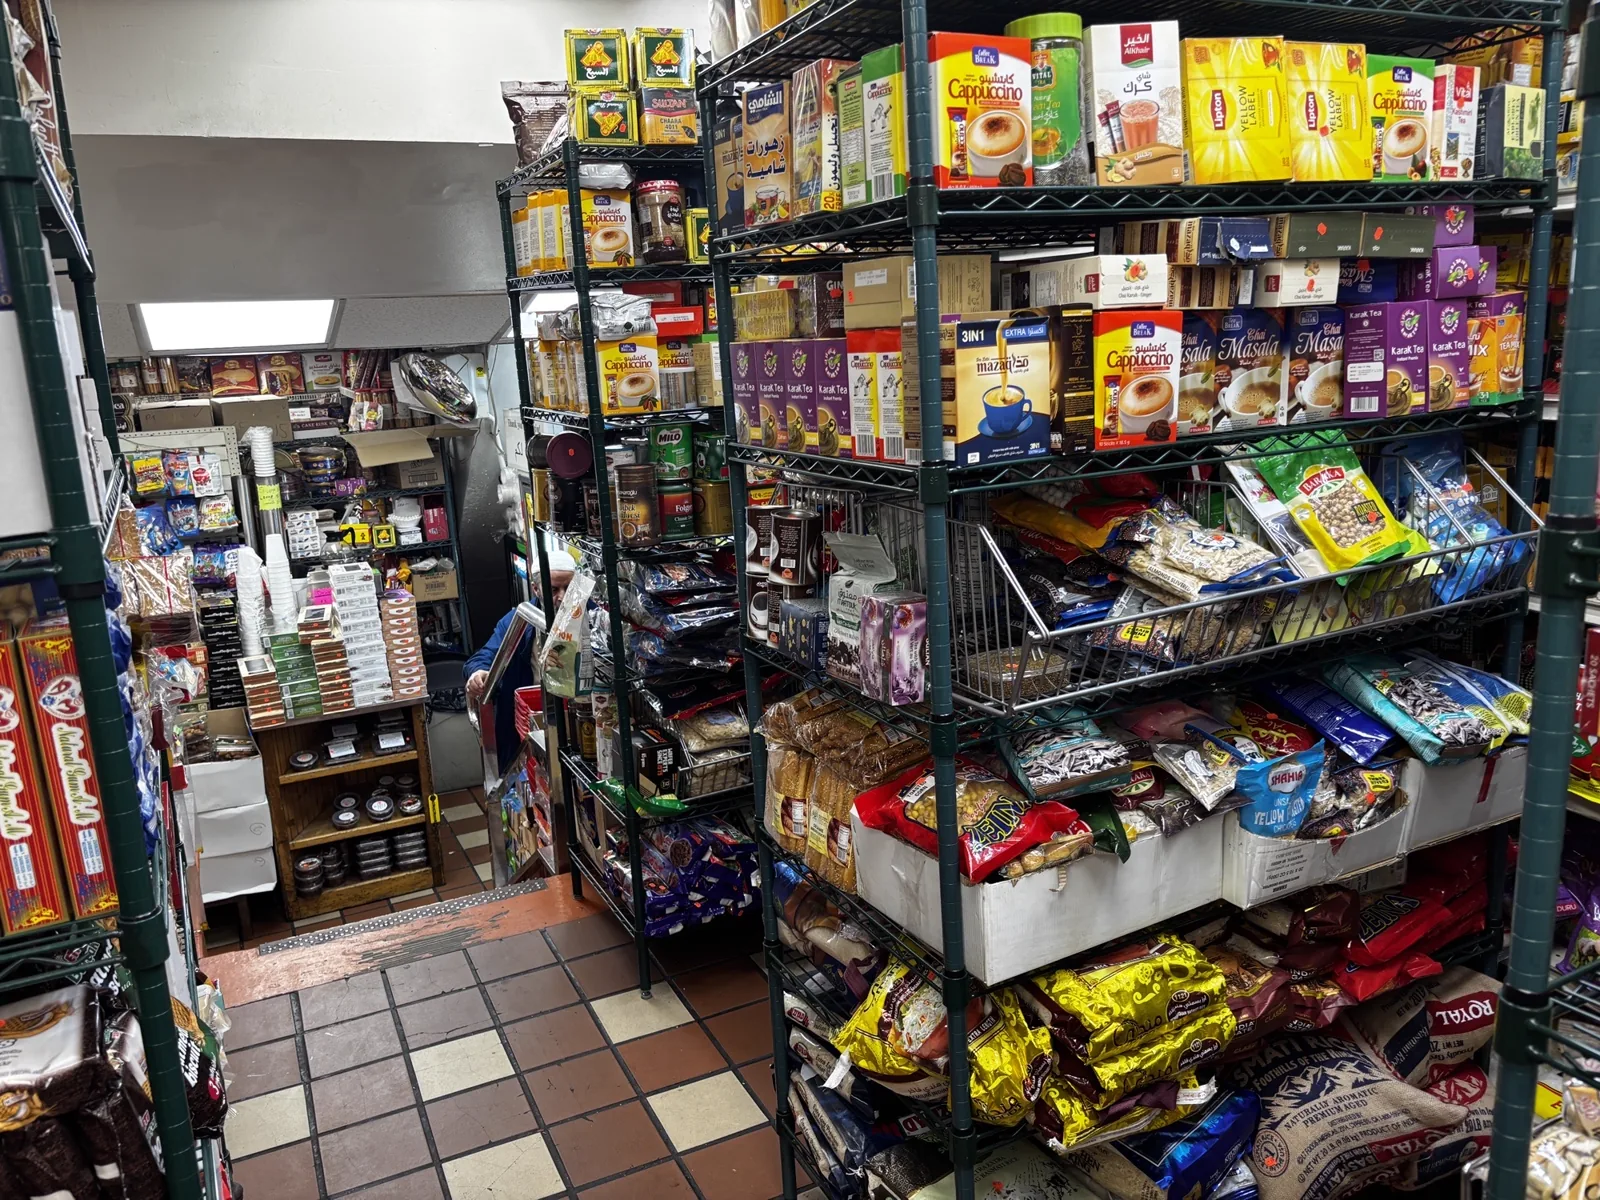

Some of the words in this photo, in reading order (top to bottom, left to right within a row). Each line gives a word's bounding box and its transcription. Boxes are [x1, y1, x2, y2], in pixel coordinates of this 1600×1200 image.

[1124, 33, 1149, 47] الخير
[975, 55, 996, 64] BREAK
[979, 73, 1014, 85] كابتشينو
[1136, 71, 1151, 83] شاي
[948, 79, 1022, 105] Cappuccino
[1123, 81, 1152, 95] كرك
[1456, 86, 1472, 98] Vital
[652, 98, 686, 108] SULTAN
[748, 90, 782, 114] الشامي
[1214, 92, 1223, 127] Lipton
[1238, 85, 1249, 132] YELLOW
[1374, 93, 1427, 114] Cappuccino
[1328, 89, 1336, 134] YELLOW
[715, 128, 726, 140] 3IN1
[747, 135, 784, 158] زهورات
[746, 157, 785, 179] شامية
[582, 212, 626, 225] Cappuccino
[826, 280, 844, 290] GIN
[962, 328, 984, 342] 3IN1
[1133, 328, 1152, 336] BREAK
[1247, 328, 1266, 341] Chai
[1324, 323, 1341, 335] Chai
[1135, 342, 1167, 353] كابتشينو
[1180, 339, 1212, 363] sala
[1218, 335, 1280, 360] Masala
[1414, 345, 1424, 354] Tea
[1454, 341, 1466, 349] Tea
[605, 360, 652, 371] Cappuccino
[977, 360, 1012, 374] mazaq
[1107, 351, 1173, 373] Cappuccino
[746, 383, 755, 391] Tea
[774, 384, 784, 392] Tea
[803, 385, 813, 393] Tea
[836, 386, 847, 394] Tea
[1302, 470, 1342, 491] BARAKA
[1148, 566, 1171, 580] ALMONDS
[1591, 654, 1597, 666] 20
[1586, 667, 1597, 708] SACHETS
[56, 724, 85, 769] Natural
[65, 766, 90, 792] Gum
[1271, 771, 1303, 785] SHAHIA
[1, 781, 19, 807] Gum
[69, 790, 96, 823] A.M
[1254, 809, 1285, 825] YELLOW
[1557, 904, 1577, 912] DURU
[1357, 895, 1420, 943] ZEINA
[1435, 1000, 1494, 1025] ROYAL
[968, 1028, 981, 1042] EXTRA
[982, 1016, 996, 1034] LENGTH
[1236, 1021, 1254, 1030] DIA
[1404, 1026, 1428, 1056] Basmati
[182, 1040, 203, 1088] biscuit
[1233, 1040, 1306, 1087] SMATI
[1391, 1050, 1407, 1065] Rice
[1254, 1062, 1298, 1091] FOOTHILLS
[1300, 1056, 1310, 1066] OF
[1312, 1052, 1328, 1063] THE
[1284, 1099, 1331, 1130] NATURALLY
[1332, 1087, 1378, 1106] AROMATIC
[1304, 1107, 1342, 1128] PREMIUM
[1343, 1099, 1368, 1114] AGED
[1302, 1164, 1316, 1176] NET
[1311, 1154, 1325, 1168] WT.
[1320, 1148, 1329, 1157] 20
[1327, 1143, 1338, 1154] LB.
[1349, 1132, 1361, 1144] kg)
[1359, 1124, 1391, 1140] PRODUCT
[1390, 1121, 1401, 1132] OF
[1323, 1154, 1378, 1198] BASMATI
